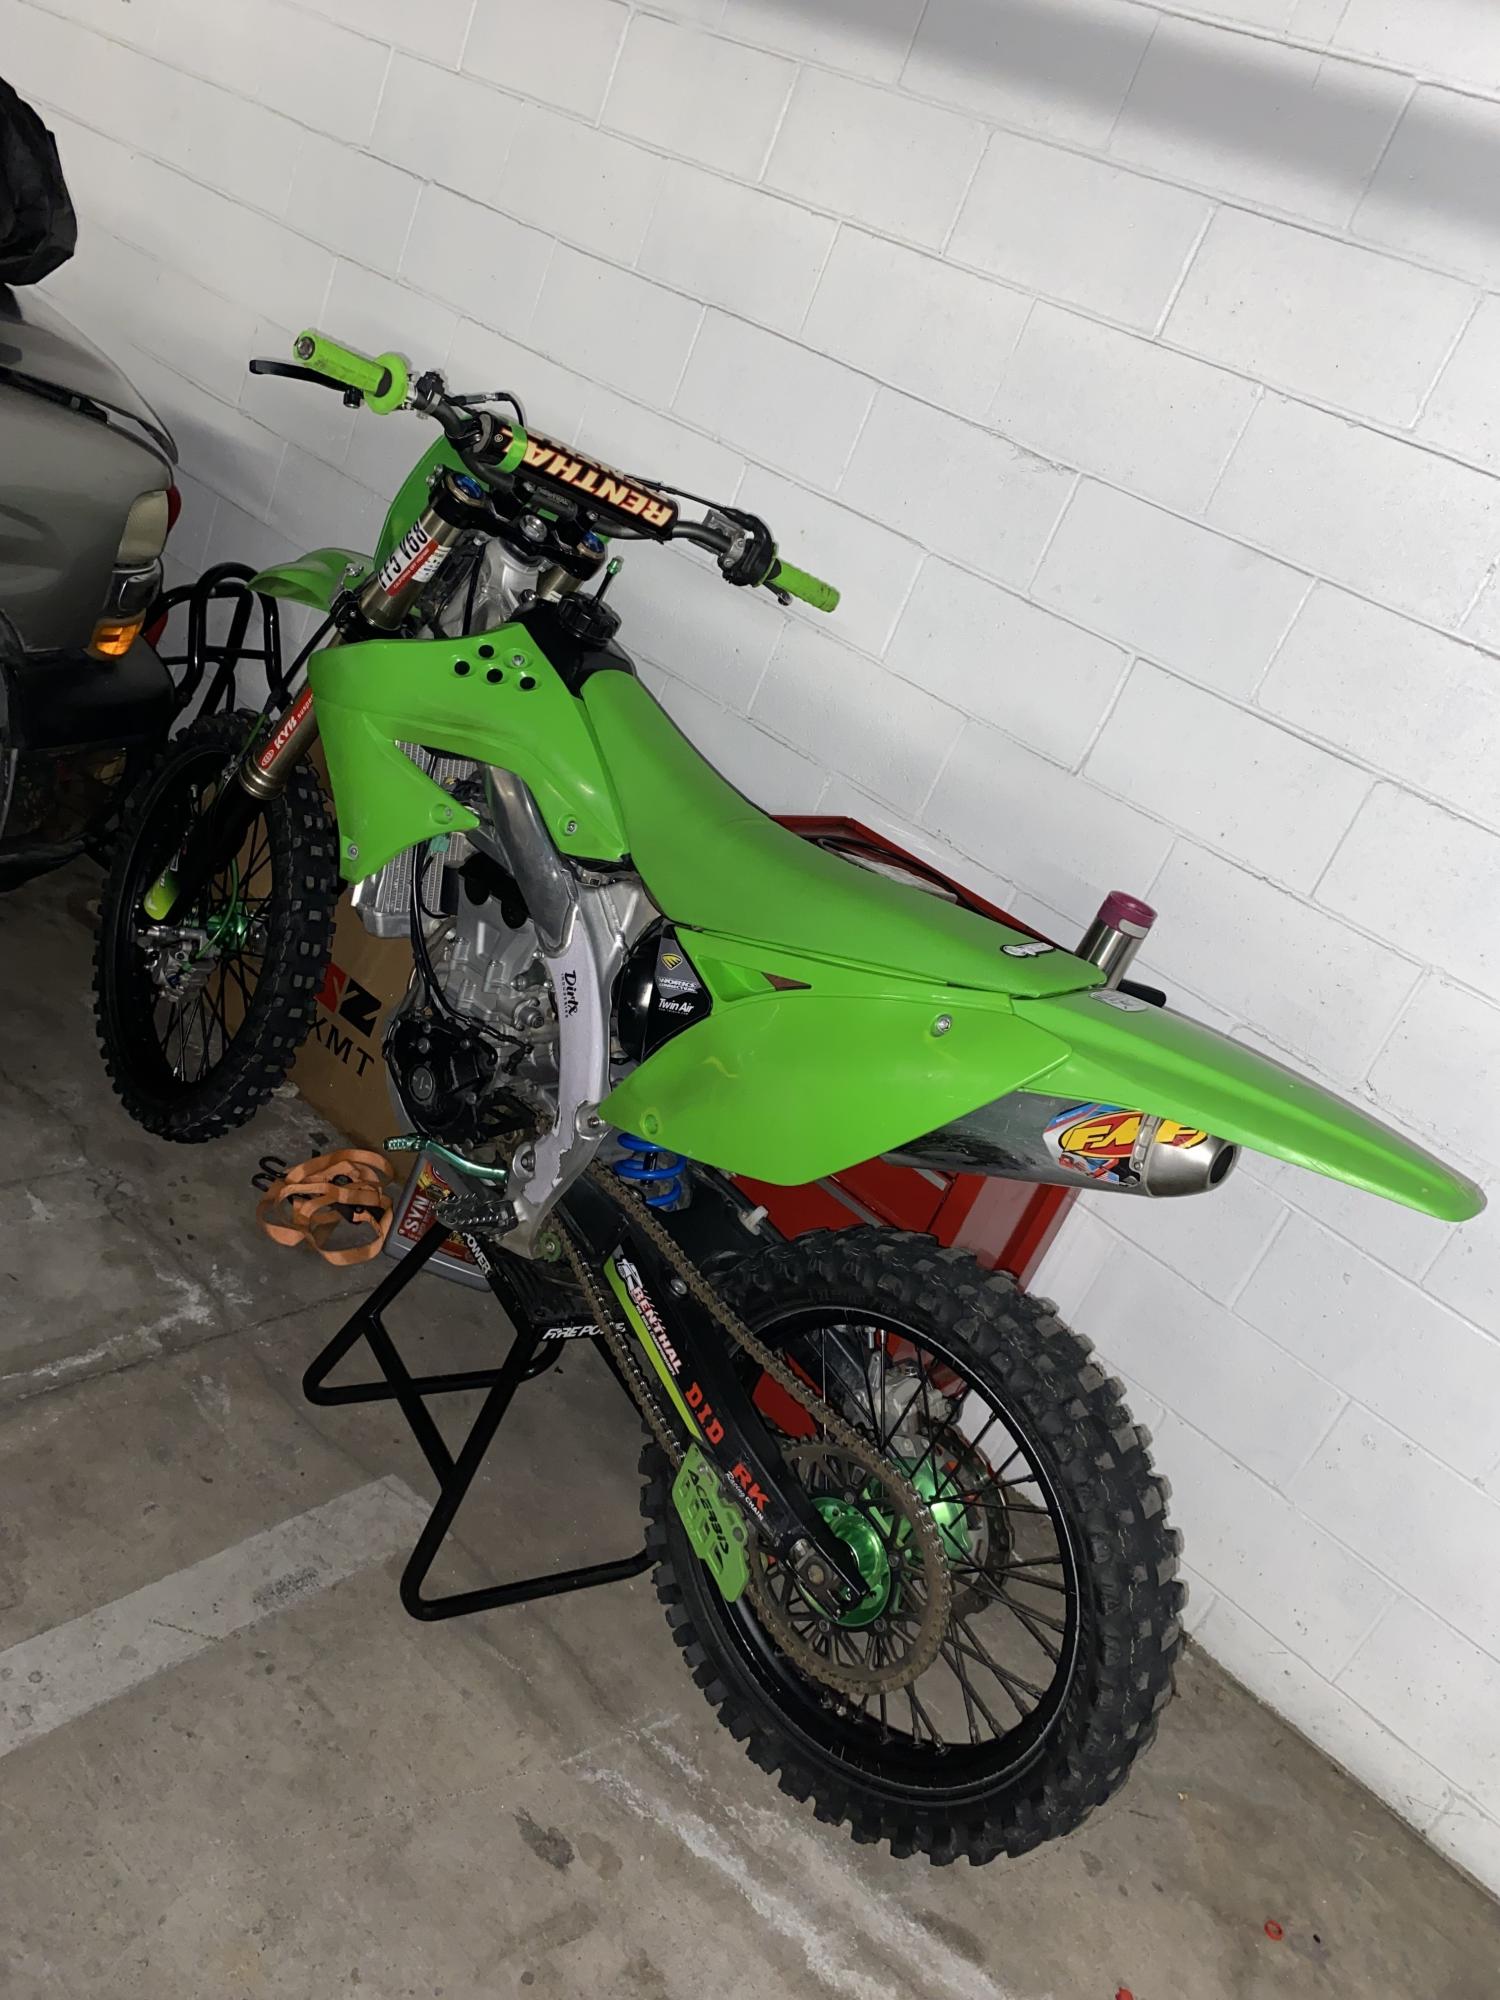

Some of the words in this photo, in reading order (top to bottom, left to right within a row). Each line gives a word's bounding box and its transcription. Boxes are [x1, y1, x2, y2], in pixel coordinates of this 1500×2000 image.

[658, 998, 680, 1011] Twin
[679, 1002, 695, 1013] Air
[632, 1287, 682, 1375] RENTHAL
[732, 1463, 770, 1511] RK
[745, 1496, 764, 1521] CHAIN
